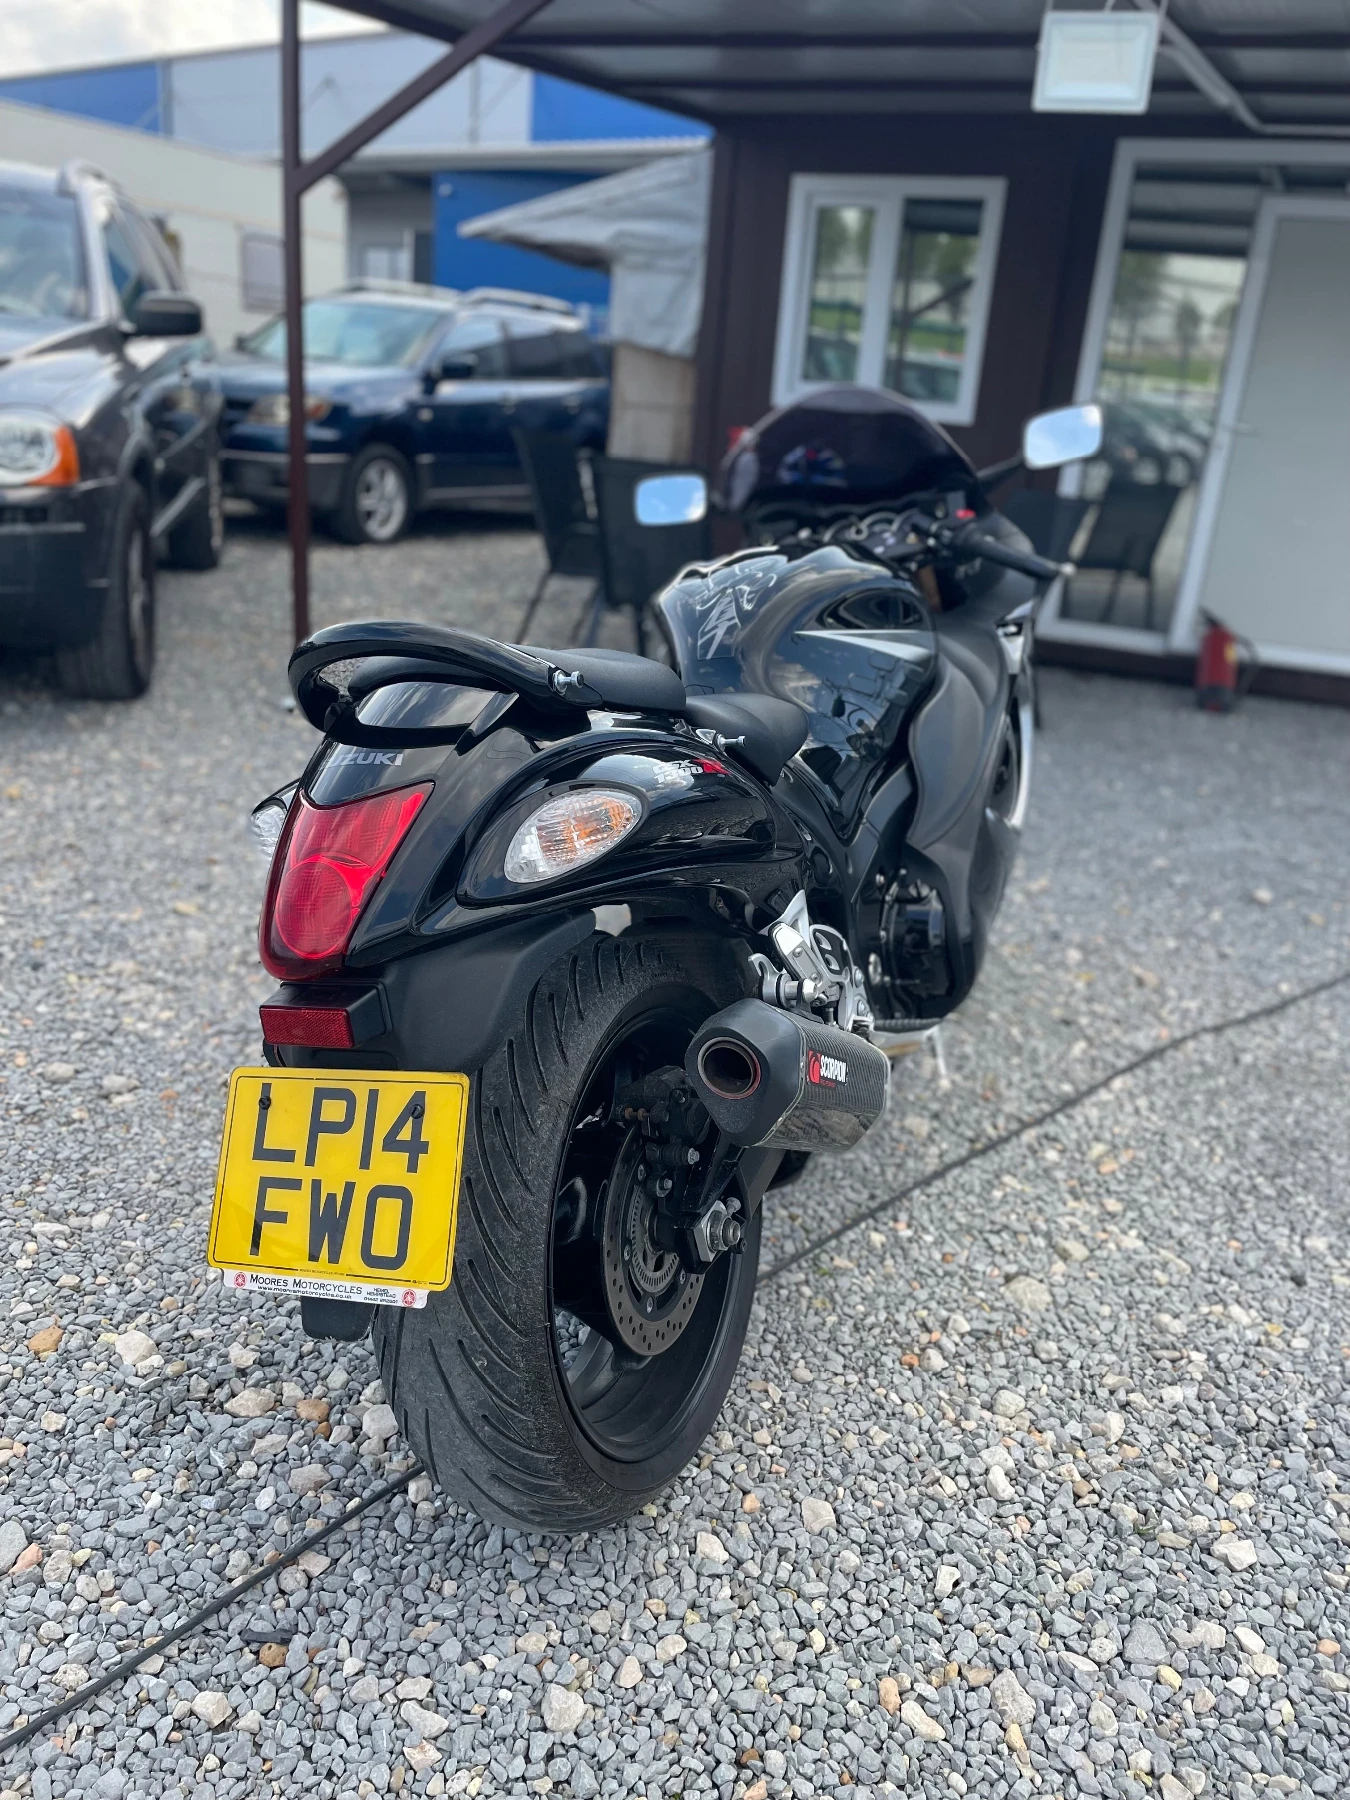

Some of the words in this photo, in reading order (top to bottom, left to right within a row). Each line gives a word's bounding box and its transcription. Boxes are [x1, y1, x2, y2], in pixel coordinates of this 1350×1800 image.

[820, 1054, 846, 1083] SCORPION
[252, 1082, 430, 1174] LP14
[249, 1175, 414, 1271] FWO
